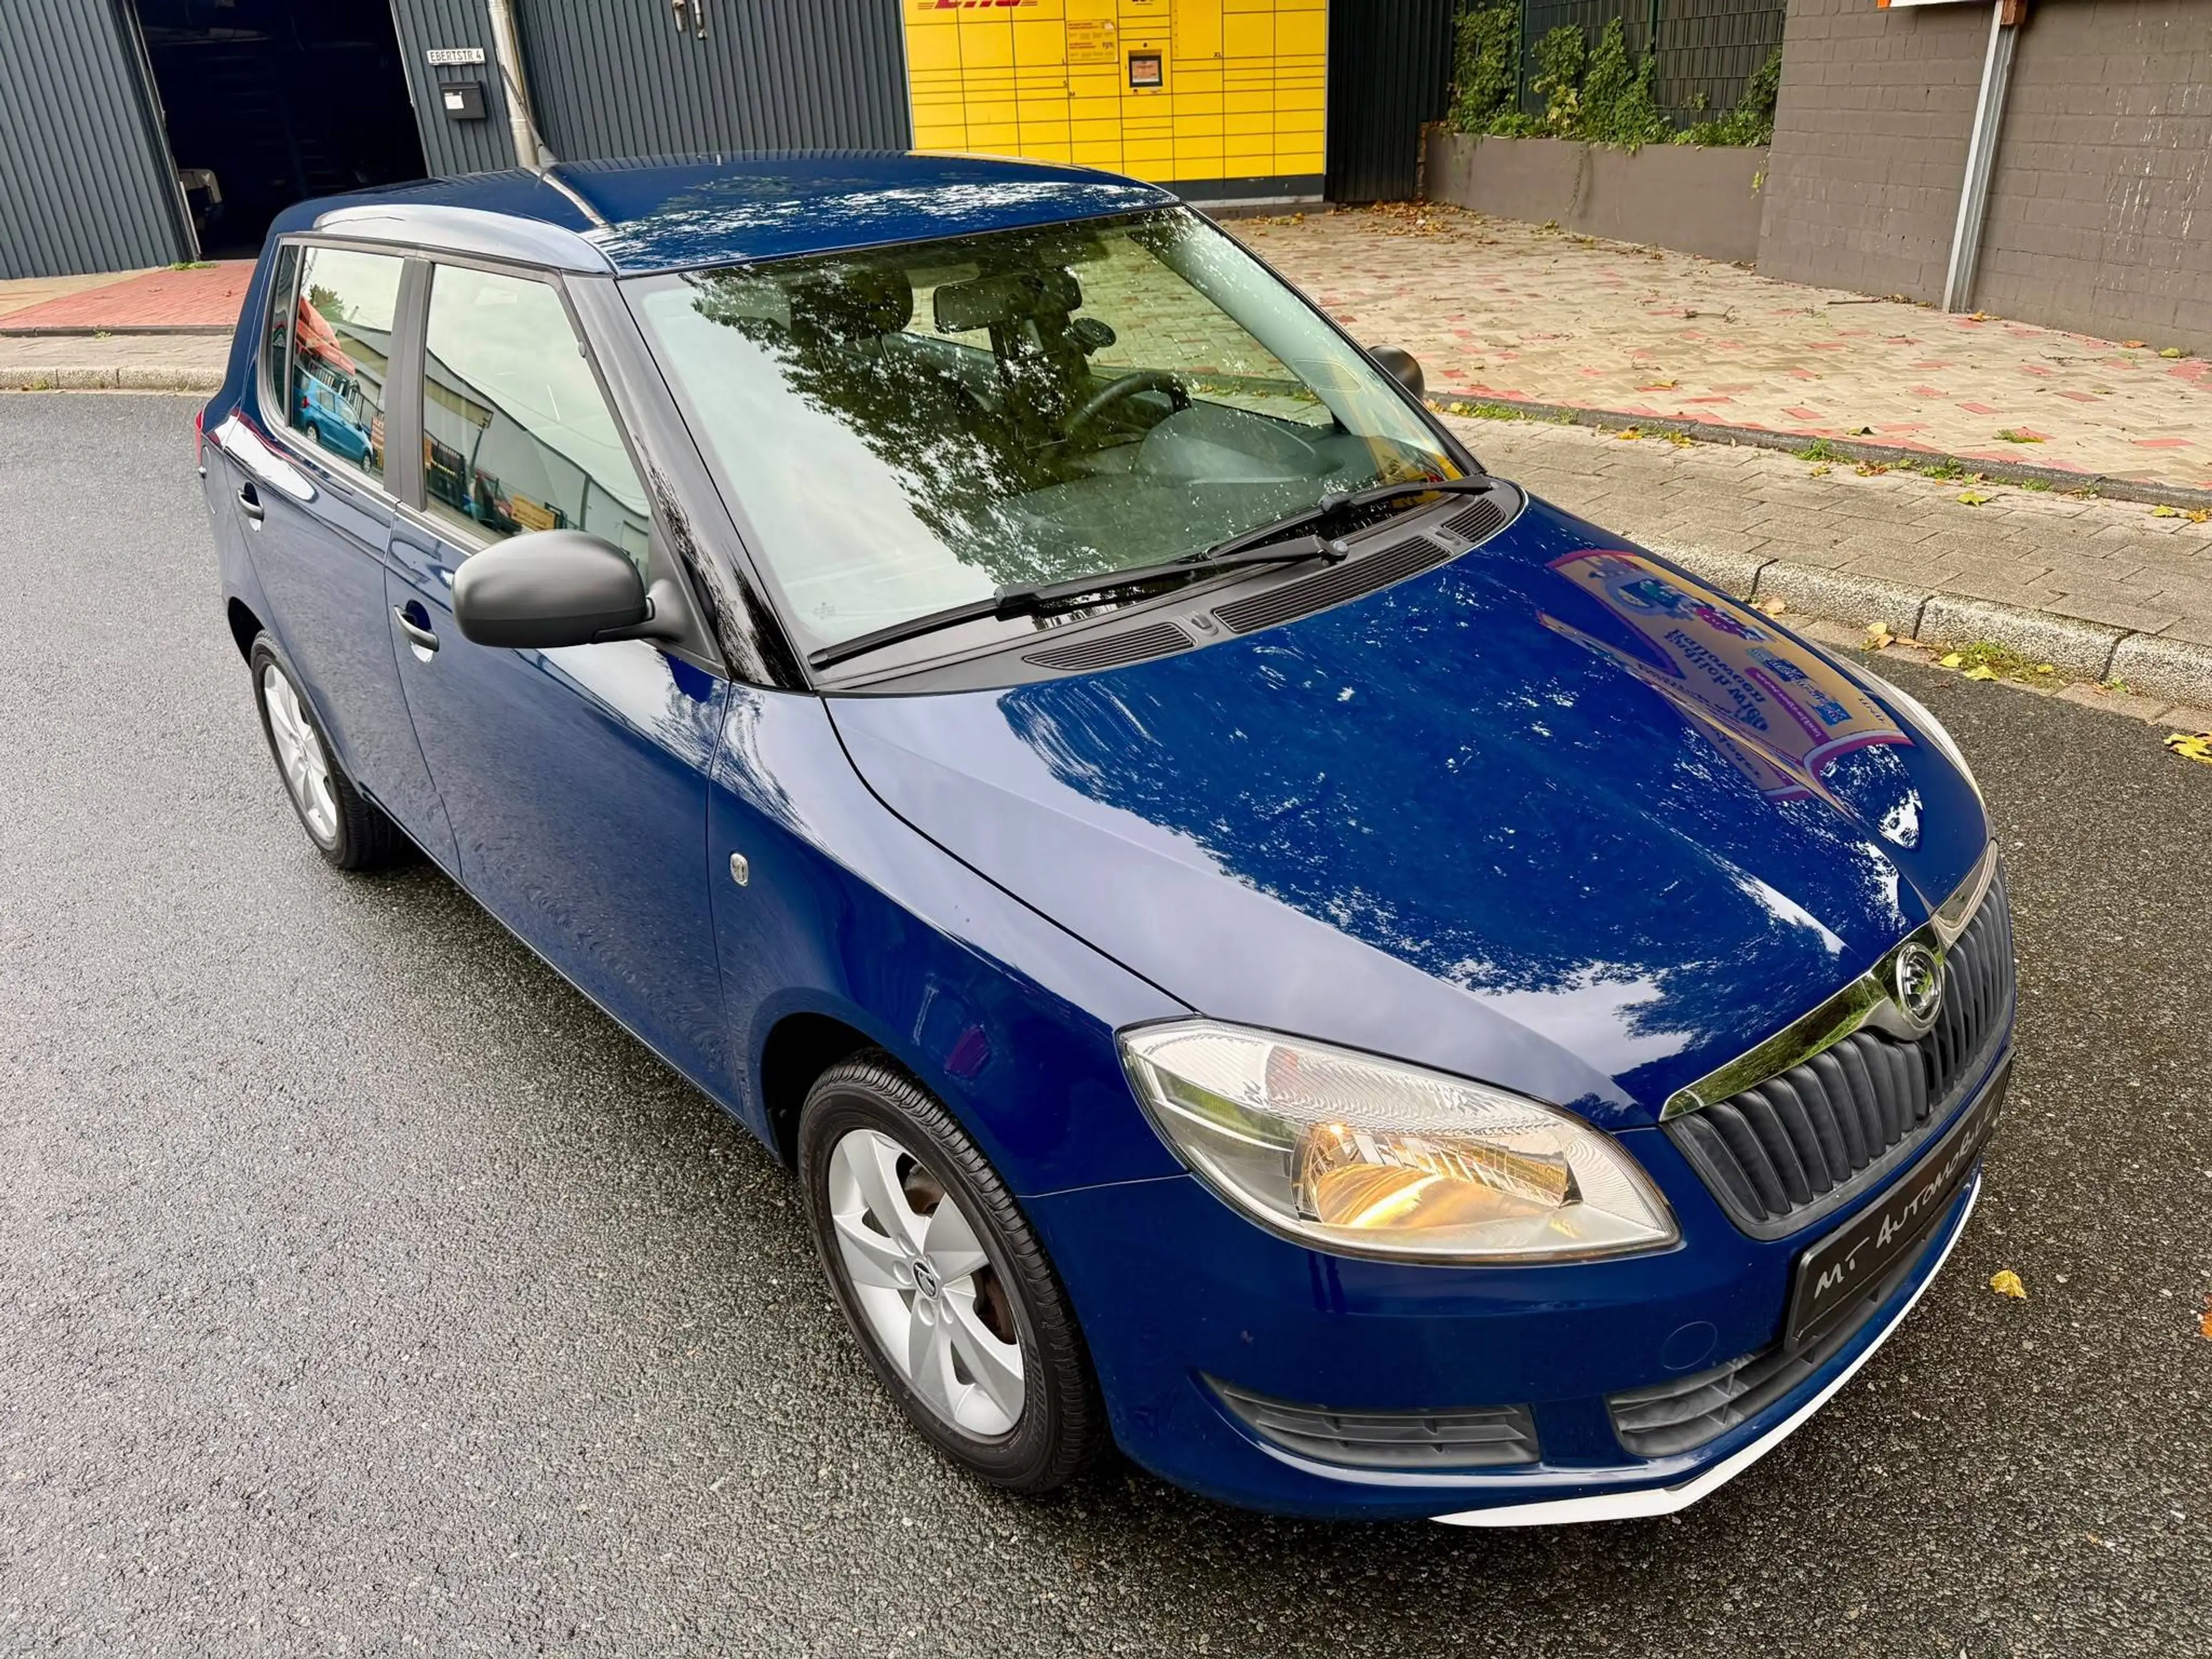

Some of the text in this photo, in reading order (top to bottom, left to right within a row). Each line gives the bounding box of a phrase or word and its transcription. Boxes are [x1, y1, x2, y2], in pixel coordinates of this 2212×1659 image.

[430, 50, 482, 62] EBERTSTR 4
[1815, 1237, 1870, 1299] MT
